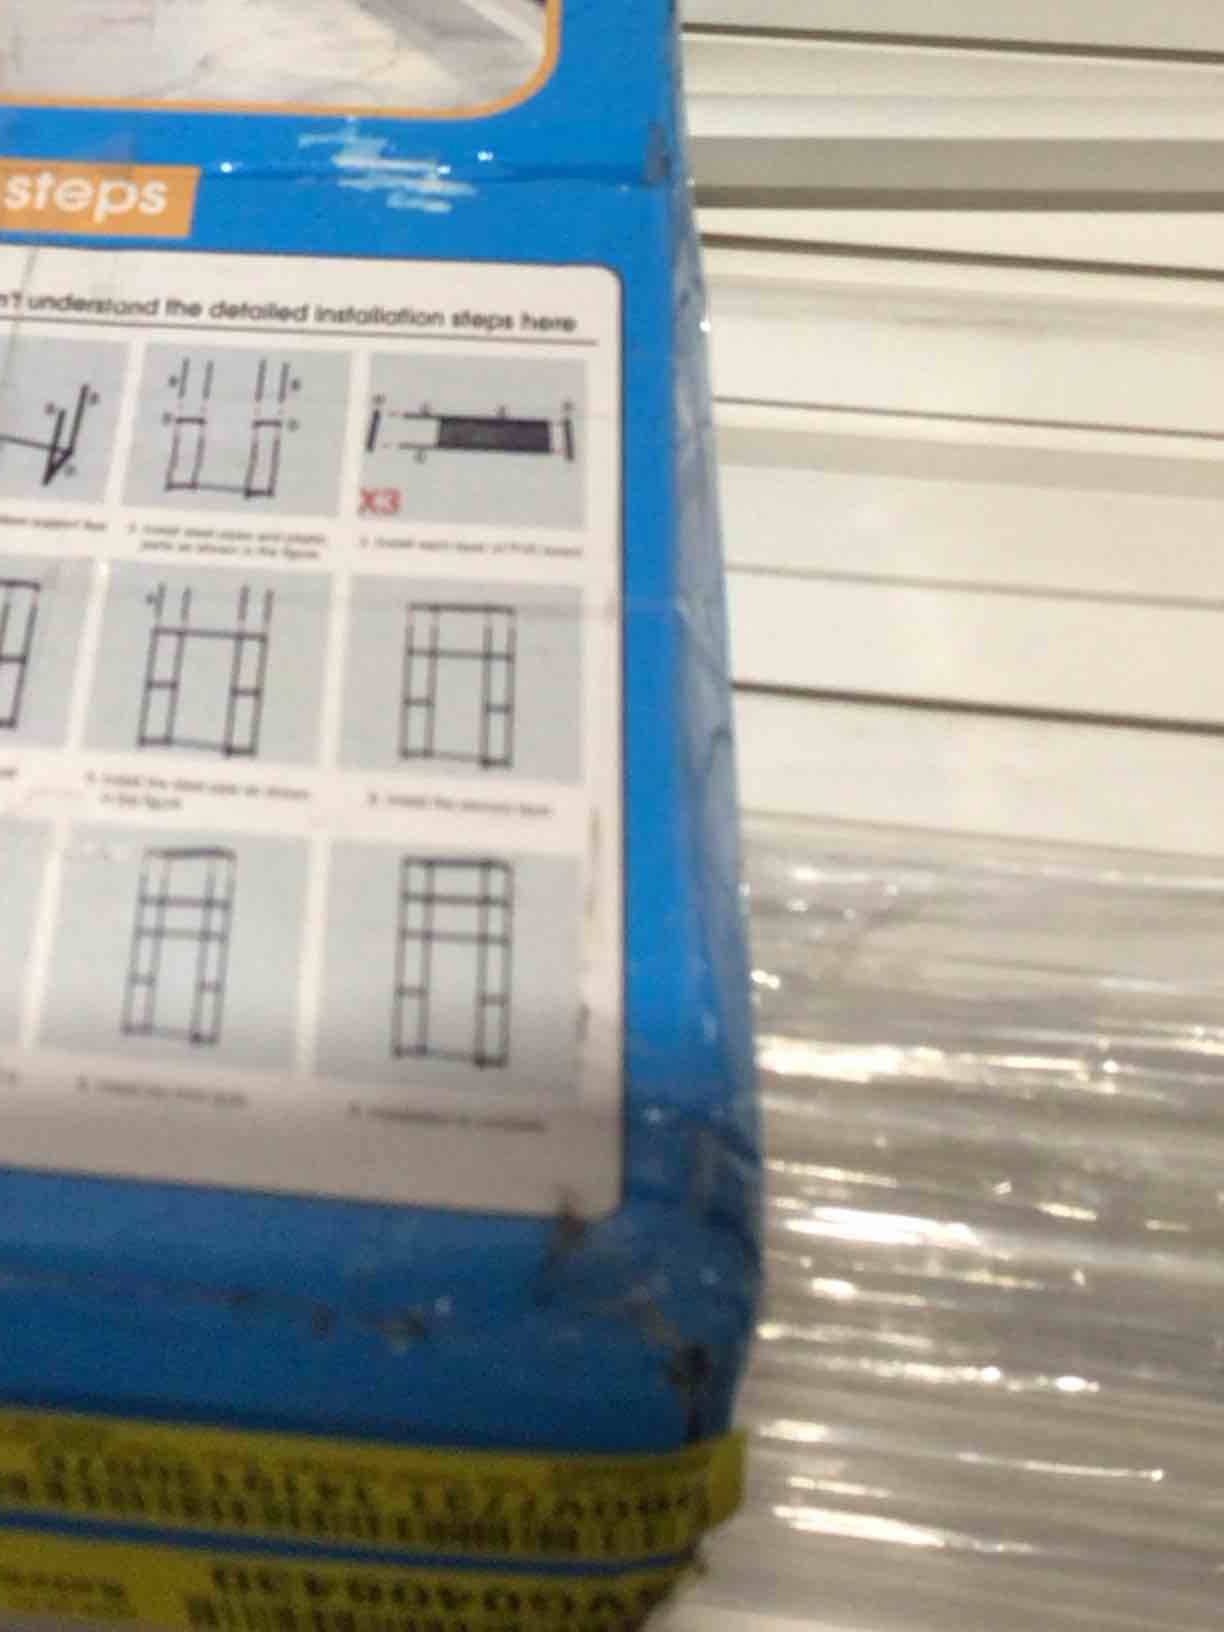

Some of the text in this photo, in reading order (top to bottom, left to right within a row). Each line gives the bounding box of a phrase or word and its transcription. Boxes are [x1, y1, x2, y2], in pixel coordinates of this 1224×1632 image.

[2, 169, 169, 223] steps
[27, 291, 160, 316] understand
[165, 297, 202, 318] the
[208, 298, 310, 322] detailed
[451, 309, 514, 335] steps
[519, 309, 578, 333] here
[358, 486, 402, 515] X3
